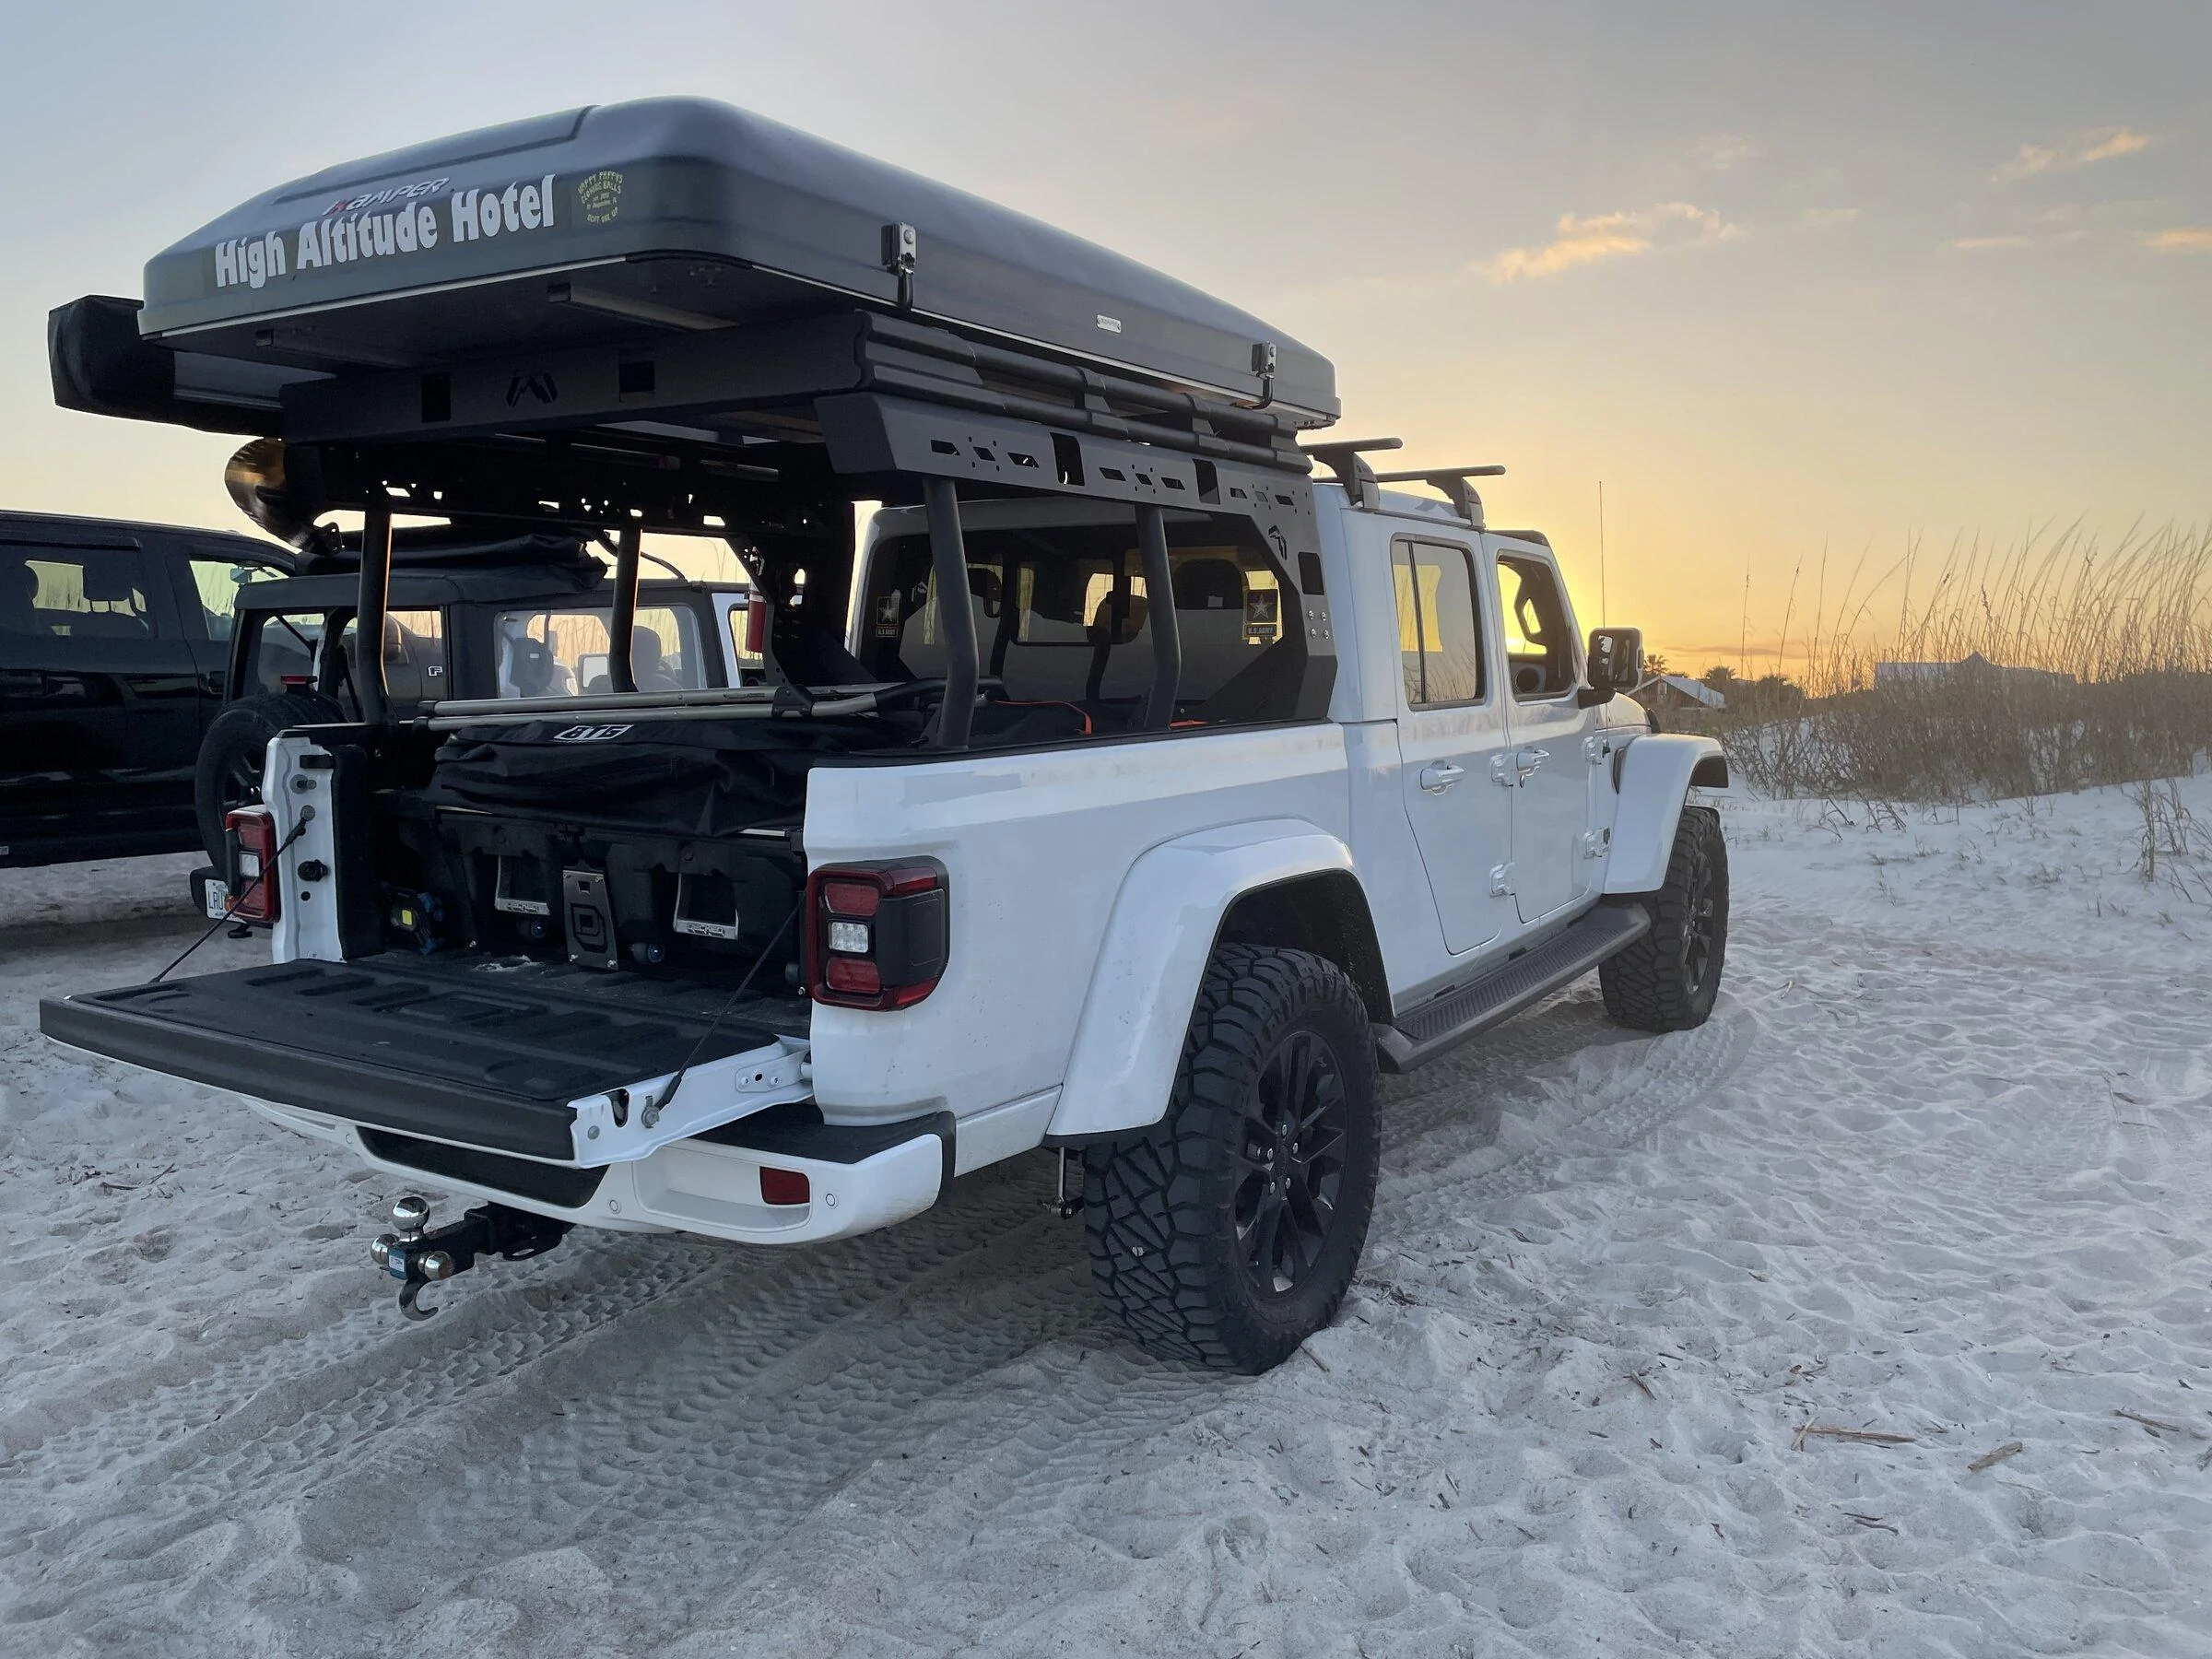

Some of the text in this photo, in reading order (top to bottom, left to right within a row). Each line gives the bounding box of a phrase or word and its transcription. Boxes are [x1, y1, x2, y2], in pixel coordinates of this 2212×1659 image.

[215, 173, 556, 289] High Altitude Hotel
